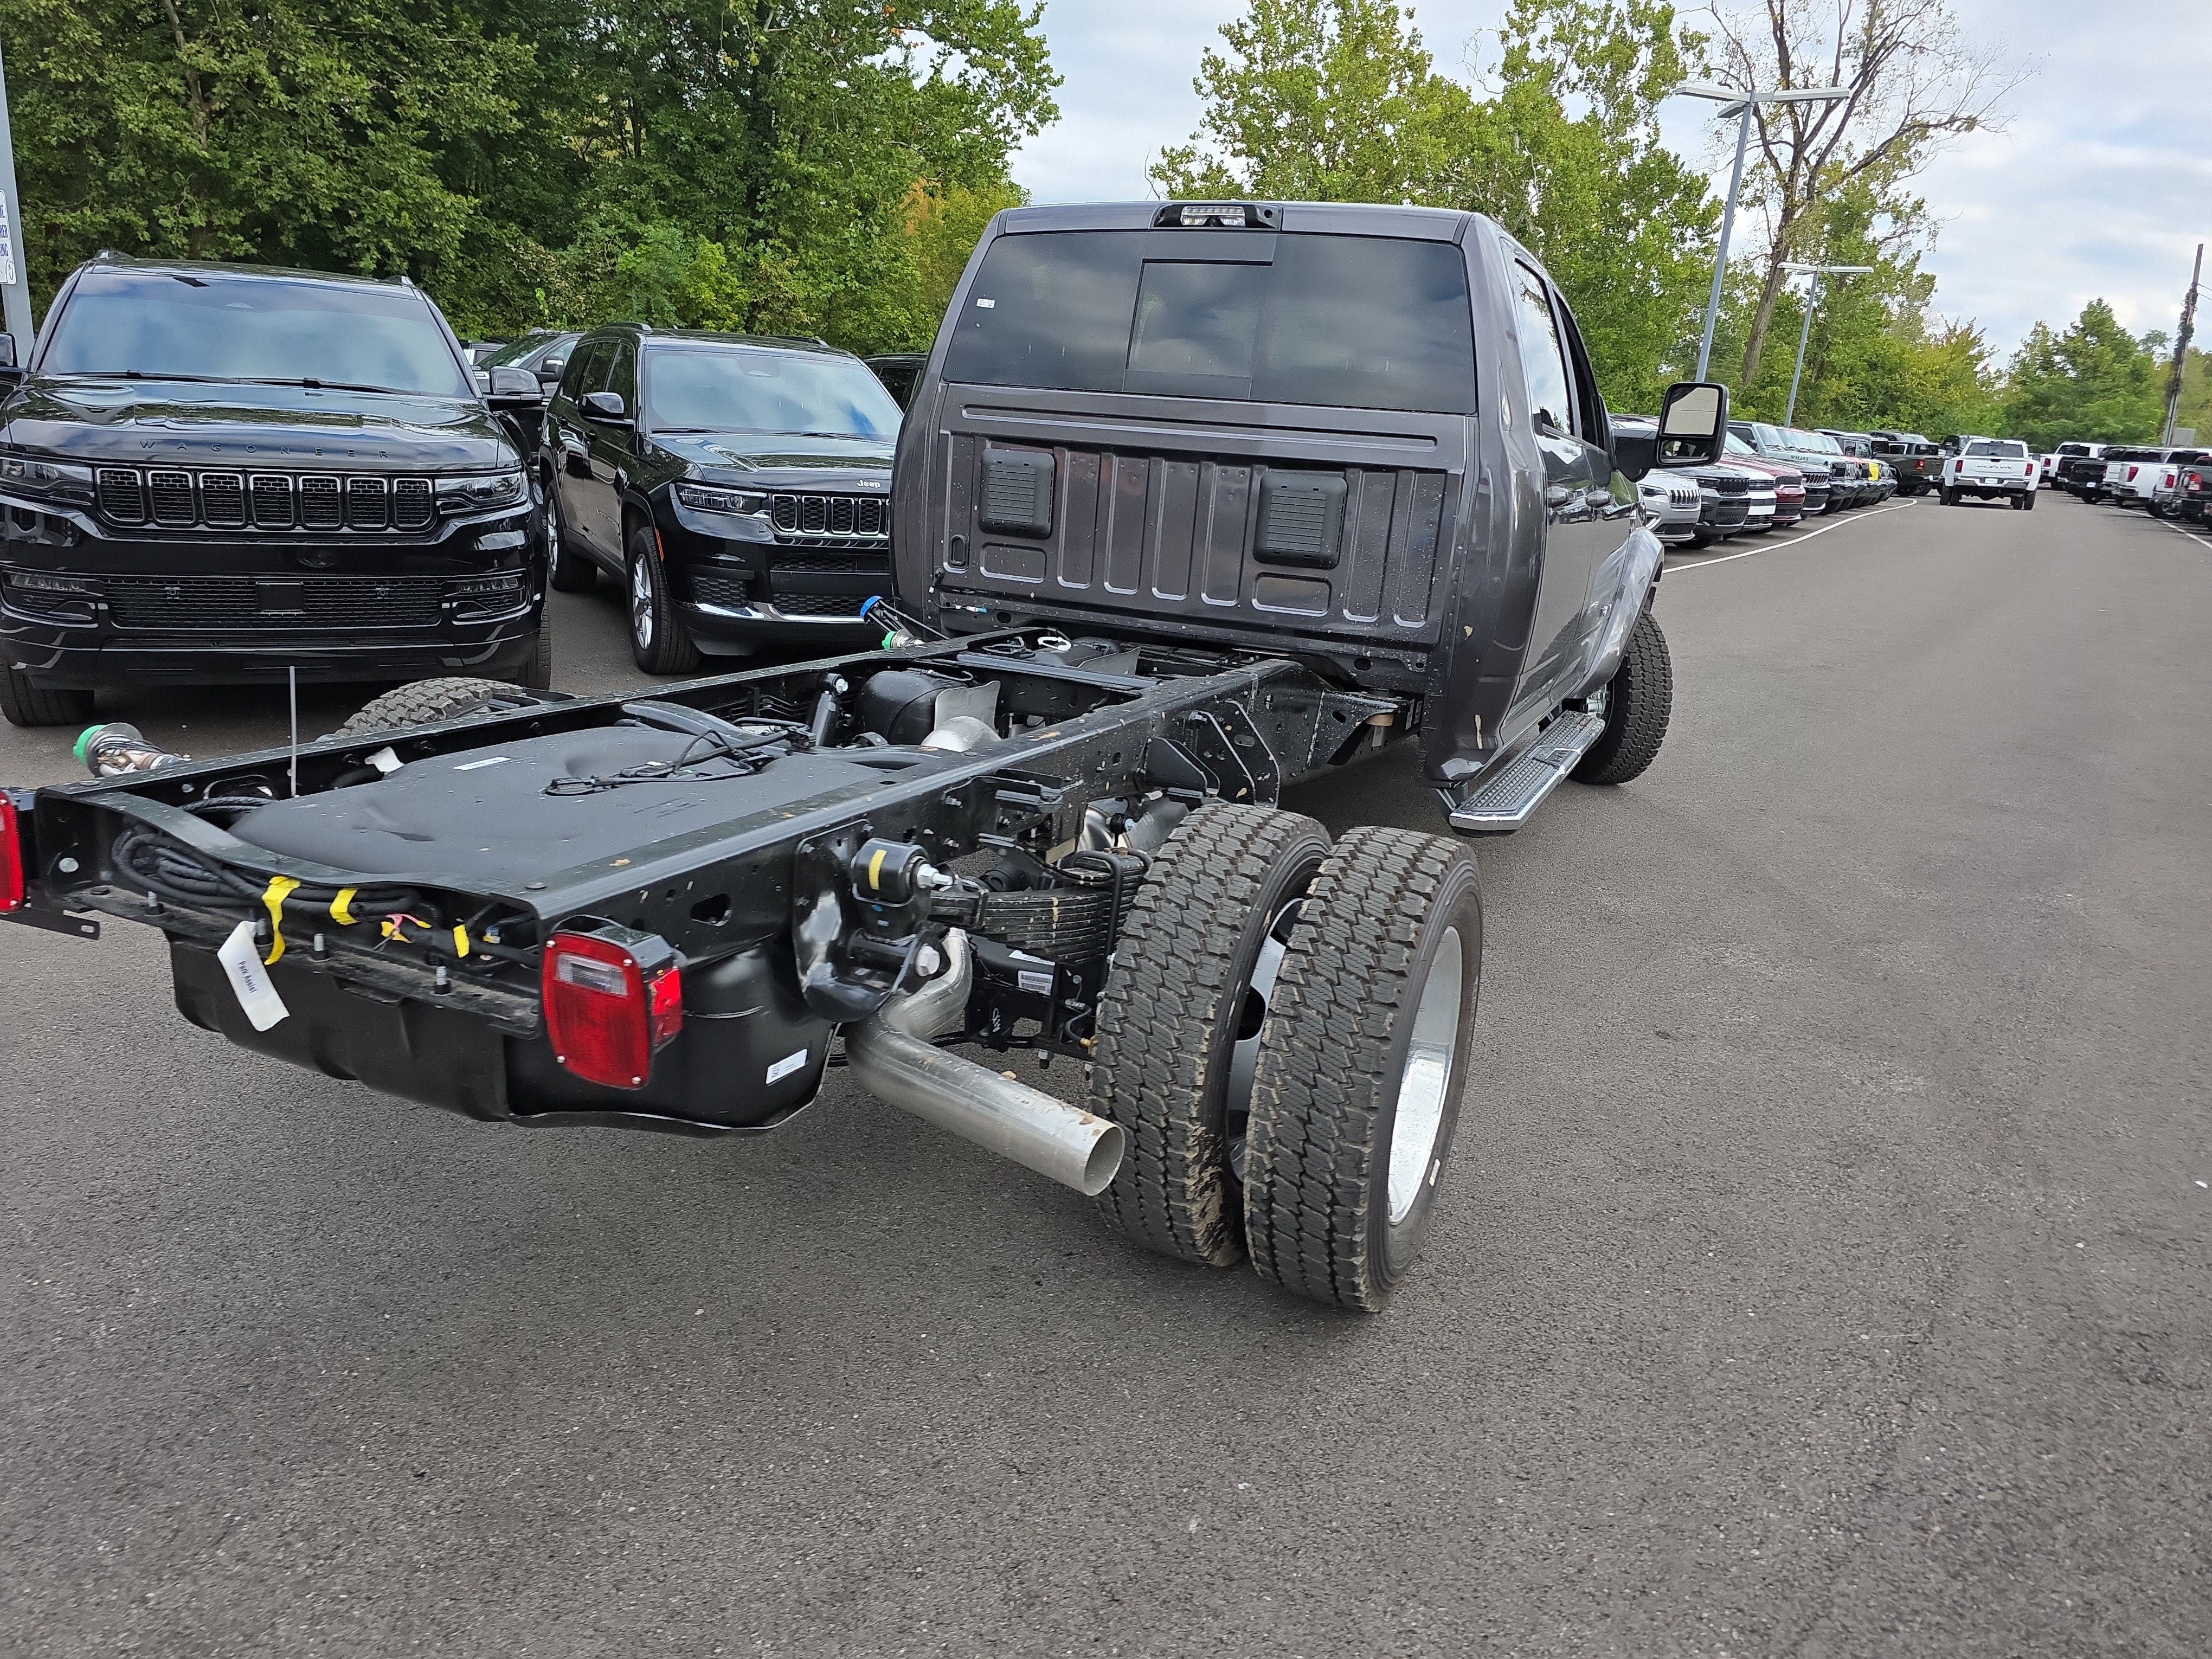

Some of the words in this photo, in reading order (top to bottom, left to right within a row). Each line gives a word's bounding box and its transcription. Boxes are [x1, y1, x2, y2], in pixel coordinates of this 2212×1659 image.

[0, 242, 9, 257] ING
[139, 440, 389, 458] WAGONEER
[857, 479, 881, 489] Jeep
